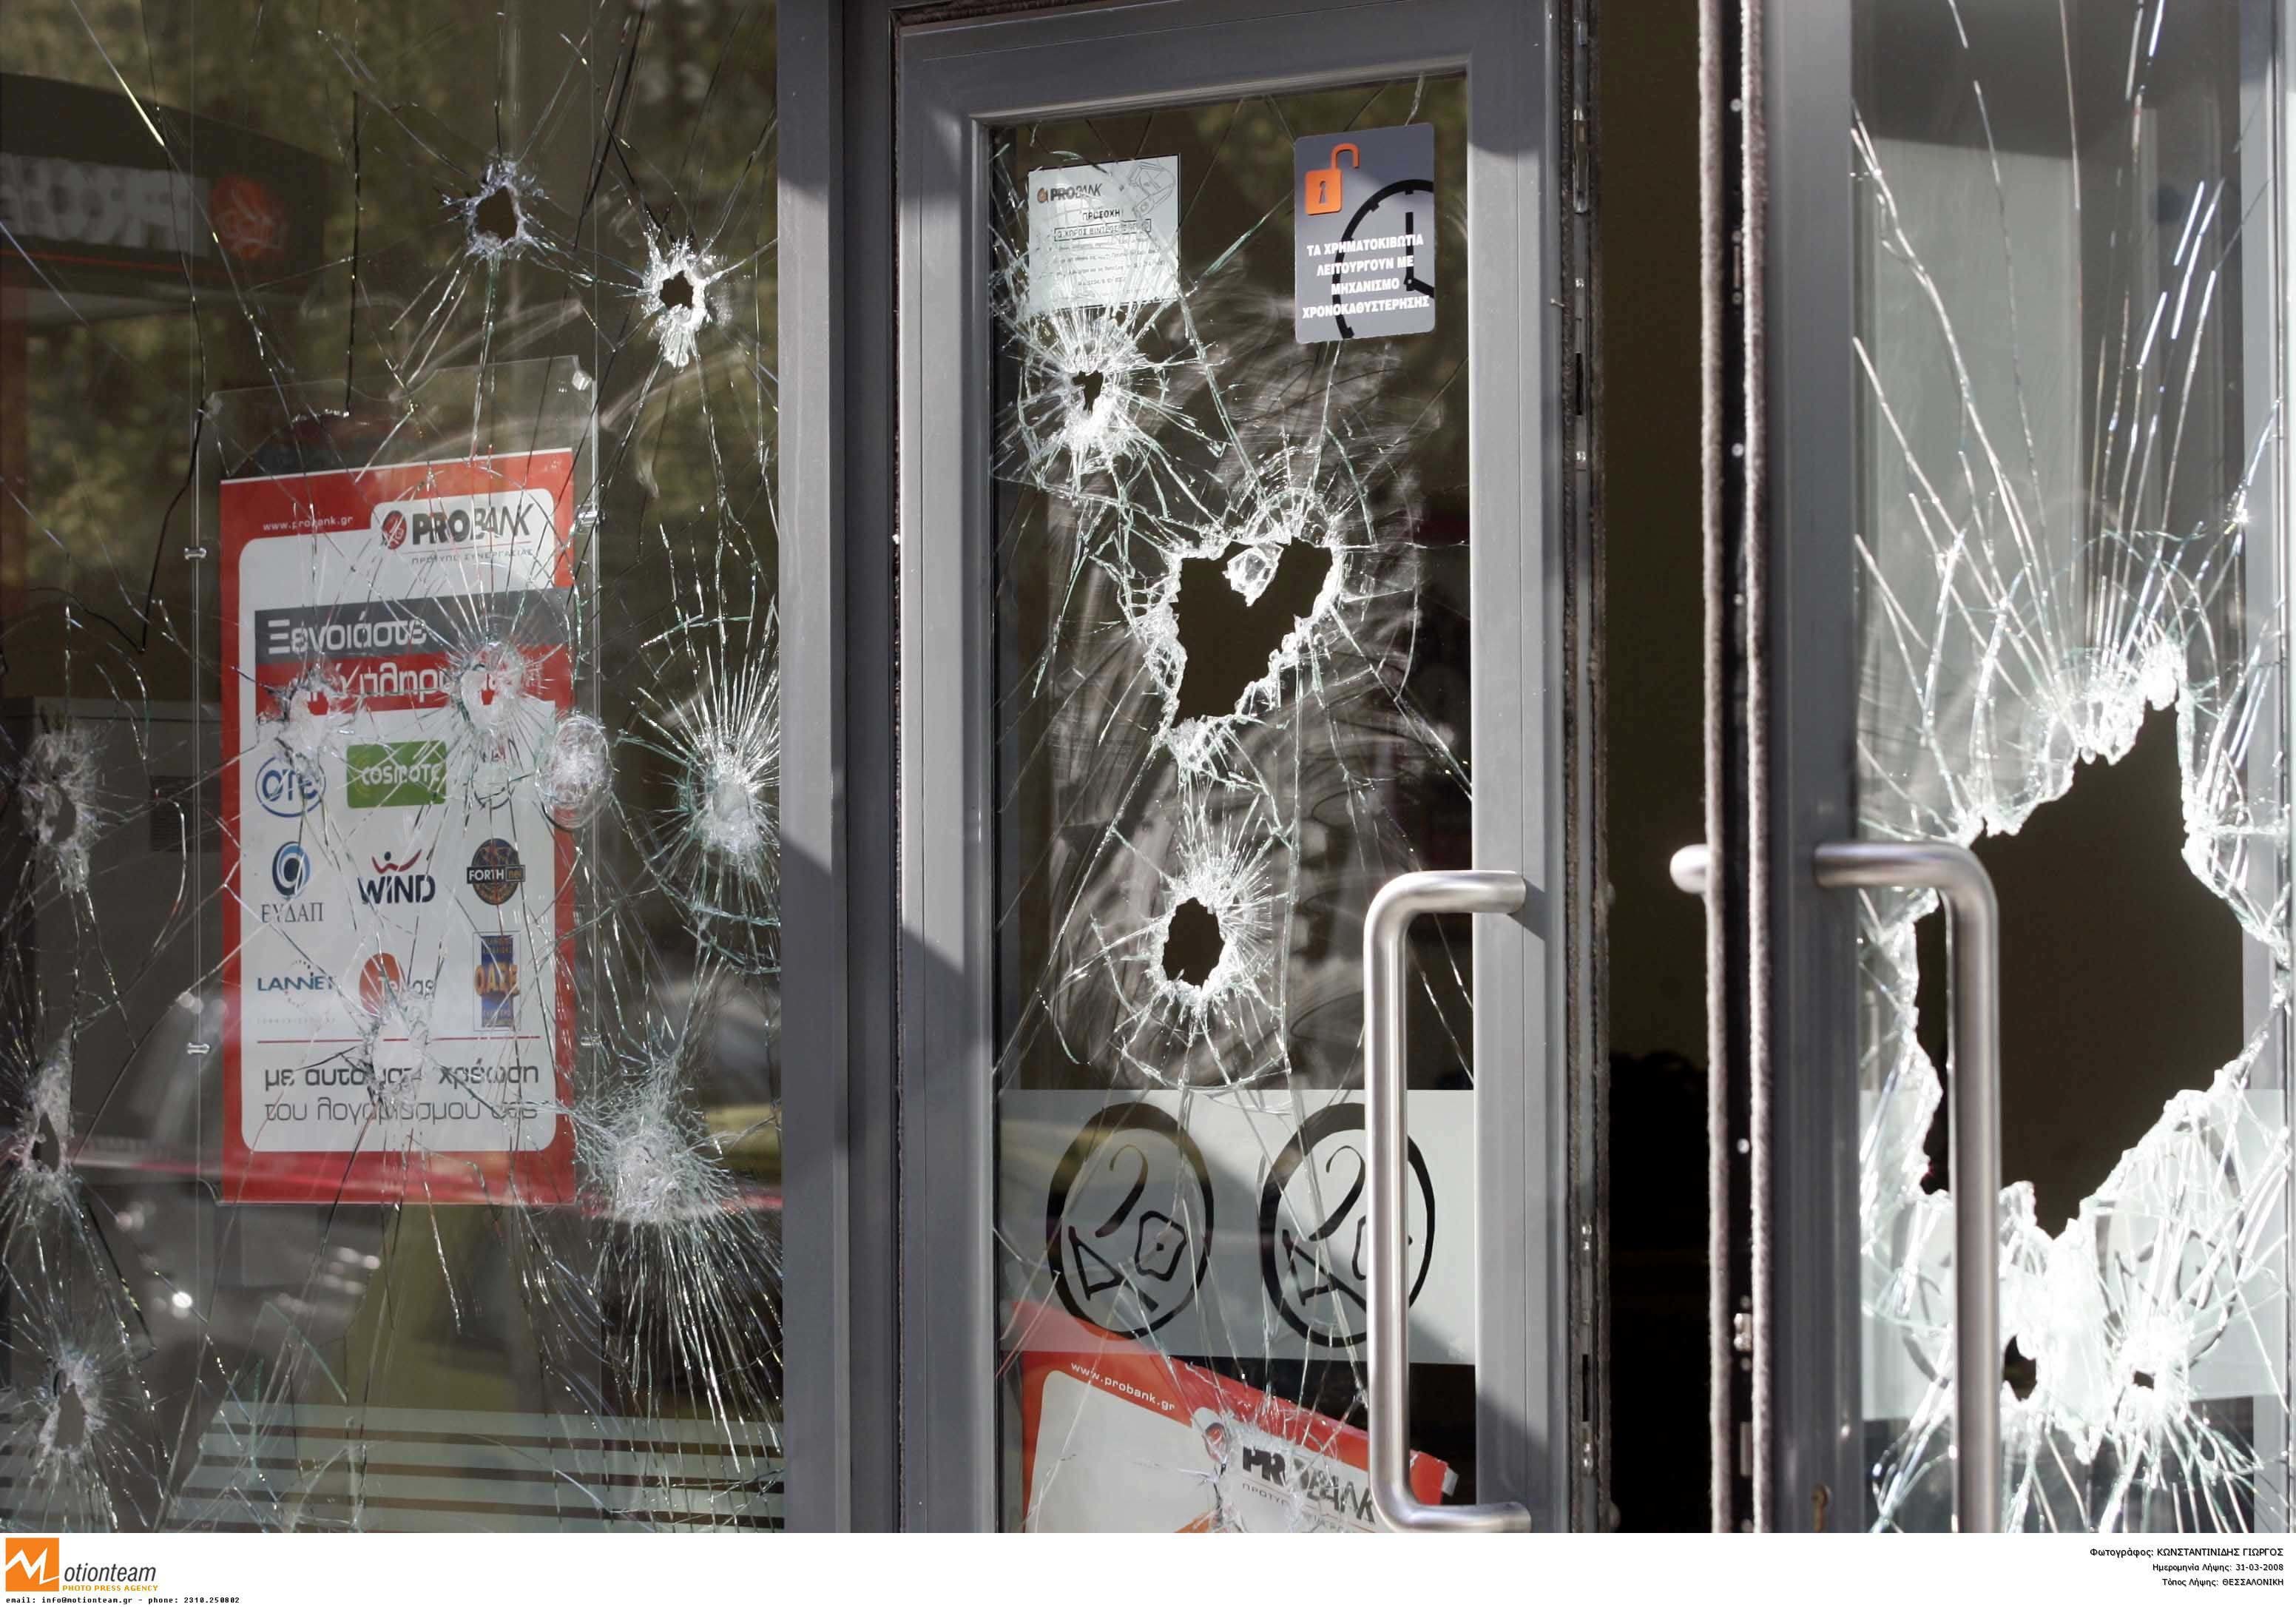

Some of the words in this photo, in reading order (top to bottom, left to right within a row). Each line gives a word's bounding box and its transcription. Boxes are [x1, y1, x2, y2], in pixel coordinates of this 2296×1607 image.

[1307, 244, 1321, 257] ΤΑ
[1323, 234, 1423, 255] ΧΡΗΜΑΤΟΚΙΒΩΤΙΑ
[1317, 257, 1394, 277] ΛΕΙΤΟΥΡΓΟΥΝ
[1397, 255, 1414, 267] ΜΕ
[1331, 278, 1399, 295] ΜΗΧΑΝΙΣΜΟ
[1302, 295, 1430, 319] ΧΡΟΝΟΚΑΘΥΣΤΕΡΗΣΗΣ
[413, 503, 535, 545] PROBANK
[268, 612, 427, 654] Ξενοιάστε
[358, 875, 436, 903] WIND
[260, 902, 324, 923] ΕΥΔΑΠ
[265, 1068, 295, 1091] με
[266, 1103, 308, 1122] του
[1070, 1361, 1175, 1412] www.probank.gr
